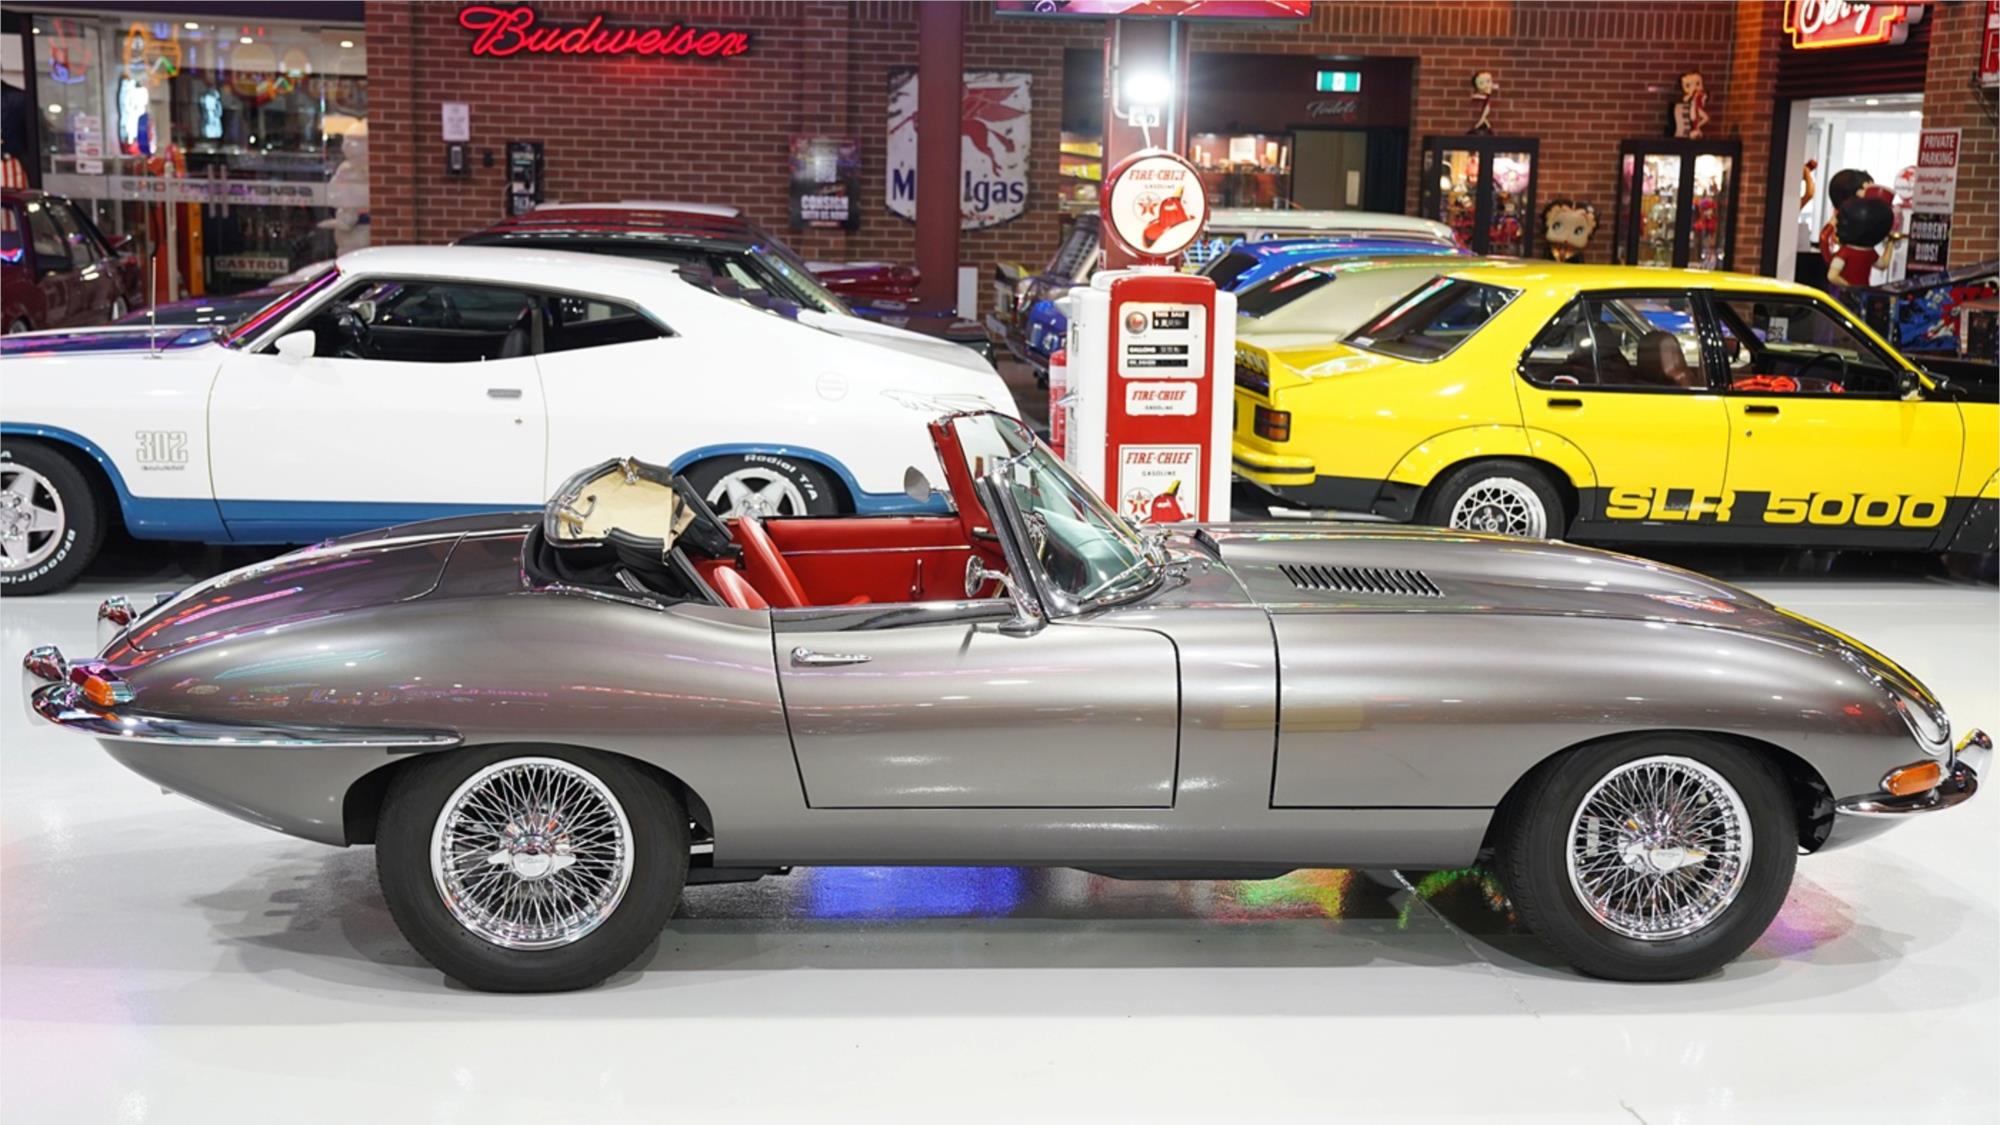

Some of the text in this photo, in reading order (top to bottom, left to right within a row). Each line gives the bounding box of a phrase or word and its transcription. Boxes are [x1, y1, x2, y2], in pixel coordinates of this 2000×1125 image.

[459, 6, 749, 57] Budweiser
[1924, 136, 1955, 149] PRIVATE
[1920, 152, 1955, 166] PARKING
[893, 169, 1024, 212] Mlgas
[1910, 221, 1948, 241] CURRENT
[1915, 243, 1939, 261] BIDS!
[216, 258, 286, 270] CASTROL
[1131, 390, 1187, 401] FIRE-CHIEF
[136, 430, 188, 464] 302
[1125, 452, 1193, 465] FIRE-CHIEF
[744, 455, 819, 501] Radial T/A
[1605, 486, 1948, 528] SLR 5000
